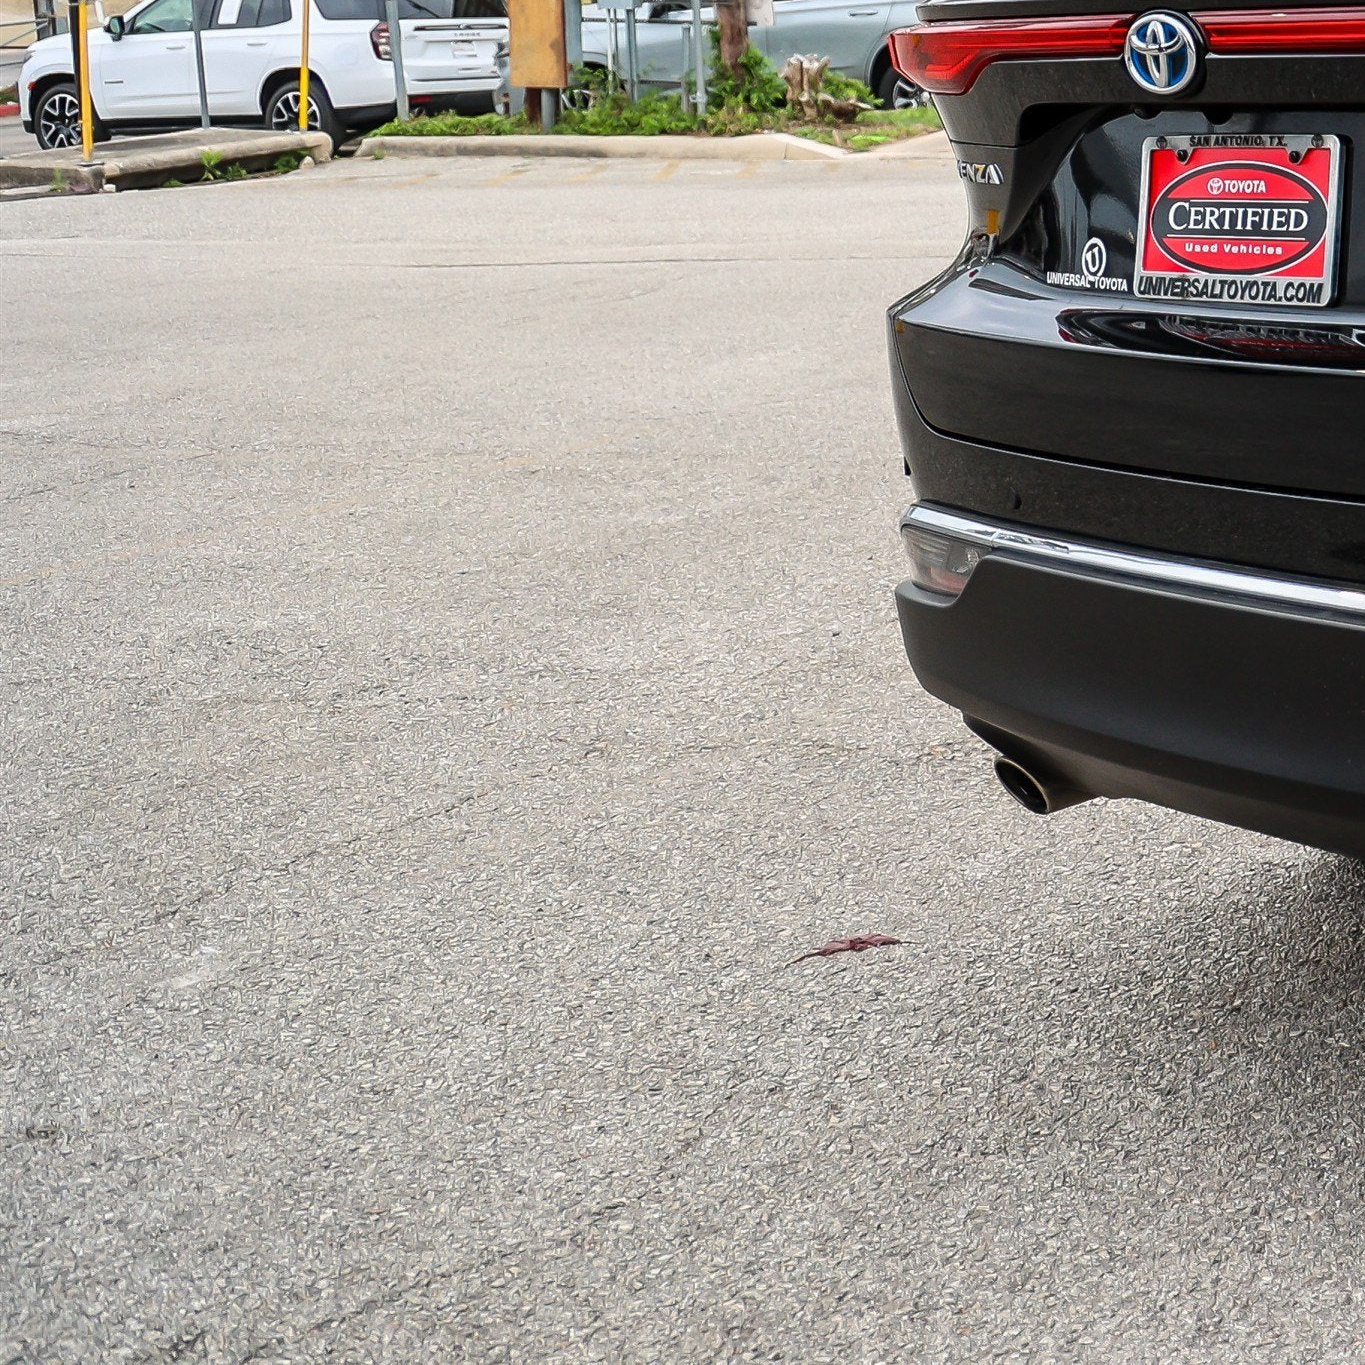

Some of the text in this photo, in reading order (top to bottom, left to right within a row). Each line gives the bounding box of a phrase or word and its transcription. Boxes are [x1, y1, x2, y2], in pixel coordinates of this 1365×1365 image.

[1190, 135, 1211, 147] SAN
[1224, 180, 1266, 193] TOYOTA
[1168, 201, 1309, 232] CERTIFIED
[1185, 242, 1283, 255] Used Vehicles
[1046, 271, 1128, 292] UNIVERSAL TOYOTA
[1138, 276, 1324, 303] UNIVERSALTOYOTA.COM
